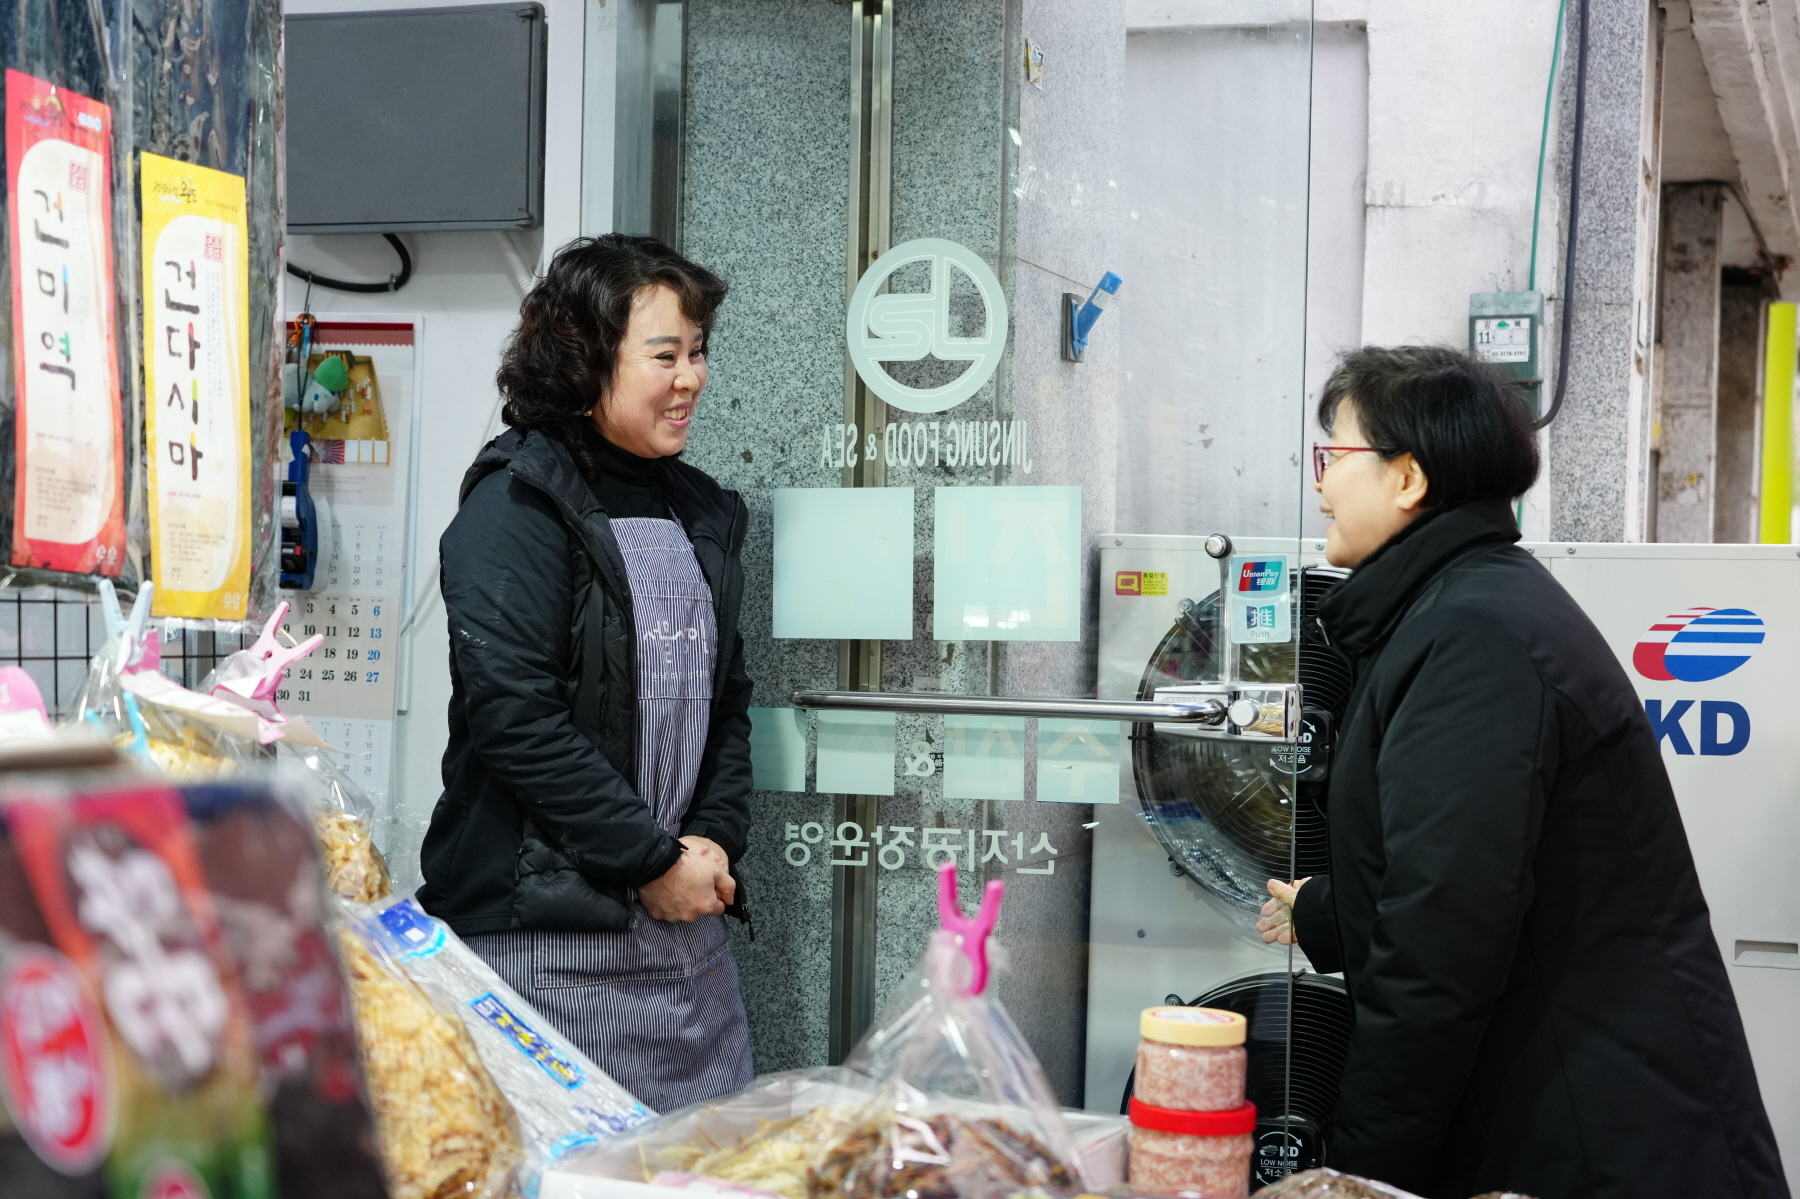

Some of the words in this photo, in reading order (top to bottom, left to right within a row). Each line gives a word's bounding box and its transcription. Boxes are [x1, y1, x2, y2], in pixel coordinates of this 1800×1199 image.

[33, 189, 76, 391] 건미역
[1478, 332, 1492, 344] 11
[164, 259, 204, 481] 건다시마
[1242, 568, 1280, 579] UnionPay
[306, 603, 314, 614] 3
[329, 604, 336, 614] 4
[352, 605, 358, 615] 5
[373, 606, 380, 616] 6
[1250, 608, 1272, 626] 推
[283, 624, 290, 634] 9
[303, 625, 315, 635] 10
[326, 626, 337, 636] 11
[348, 627, 360, 637] 12
[370, 628, 382, 638] 13
[1250, 630, 1270, 638] Push
[324, 648, 336, 658] 18
[346, 649, 358, 659] 19
[367, 650, 380, 660] 20
[300, 669, 312, 680] 24
[322, 670, 334, 680] 25
[344, 671, 357, 682] 26
[366, 672, 380, 683] 27
[276, 690, 290, 700] 30
[298, 691, 310, 702] 31
[1645, 699, 1751, 756] KD
[1278, 755, 1306, 764] 저소음
